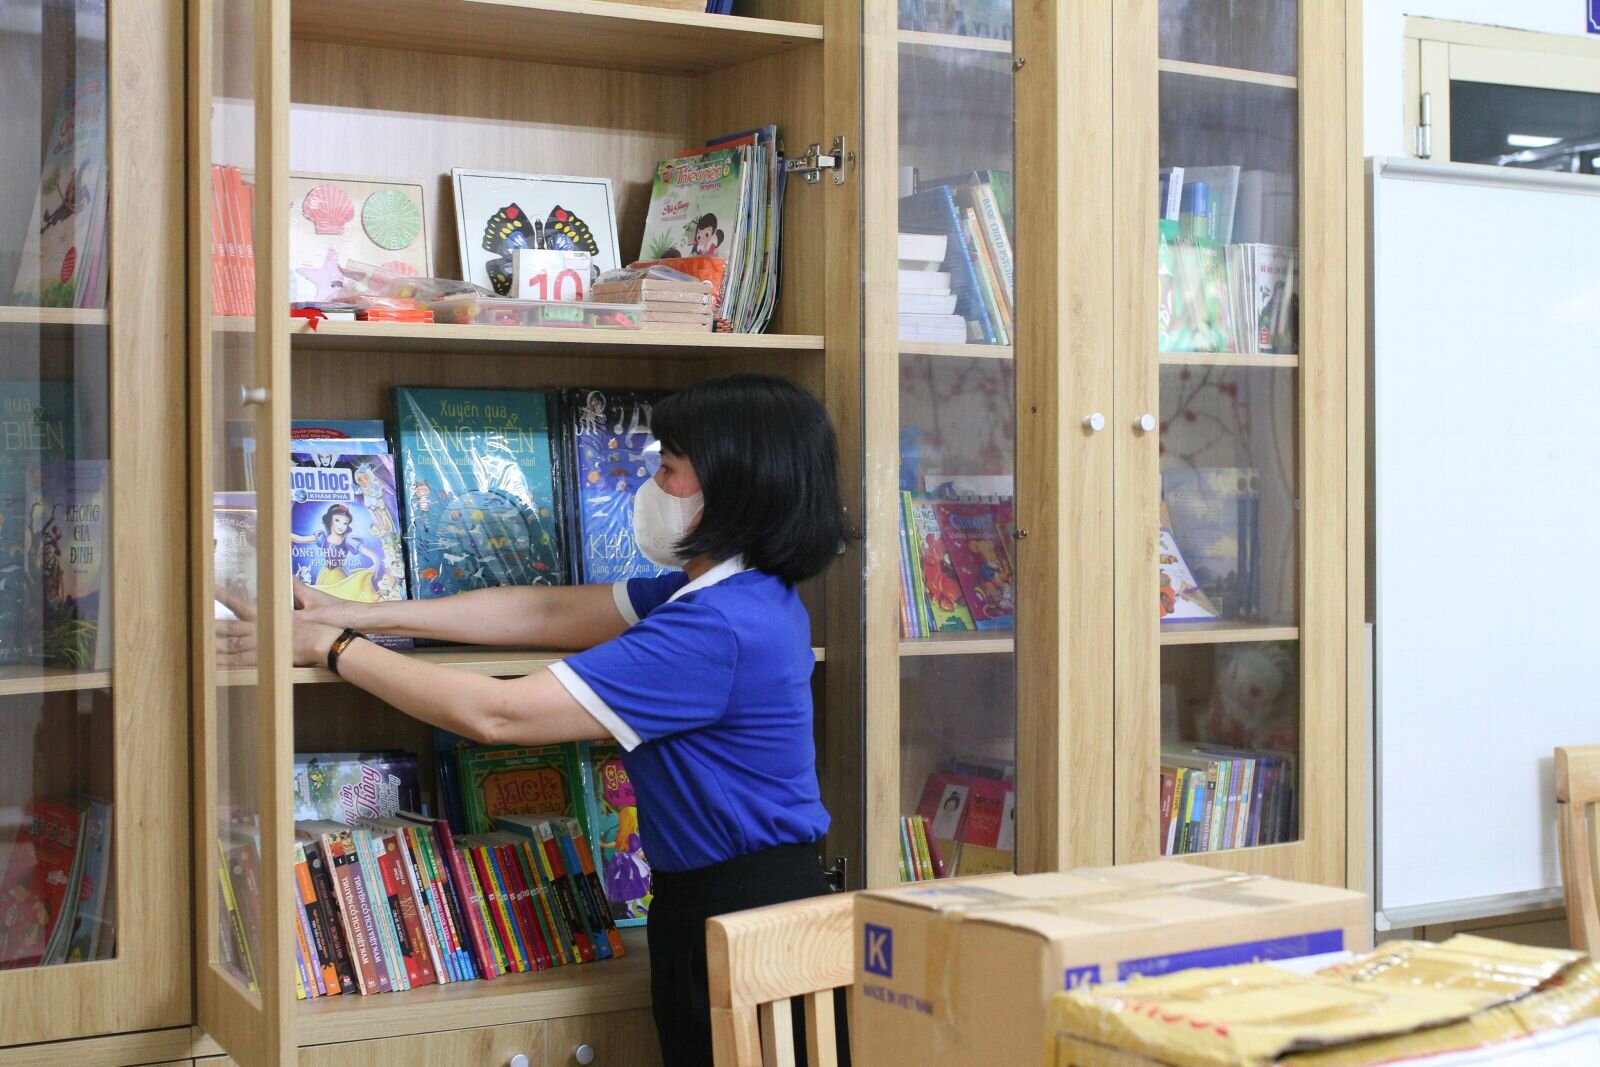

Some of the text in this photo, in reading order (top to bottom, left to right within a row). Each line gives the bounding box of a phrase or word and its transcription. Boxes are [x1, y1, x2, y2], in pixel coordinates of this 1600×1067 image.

[983, 198, 995, 221] BASIC
[990, 223, 1004, 248] CHILD
[529, 268, 583, 300] 10
[4, 398, 31, 415] qua
[441, 400, 507, 423] Xuyên qua
[318, 470, 350, 493] học
[309, 492, 347, 500] KHÁM PHÁ
[73, 524, 90, 542] GIA
[292, 545, 346, 557] ÔNG CHÚA
[590, 528, 636, 559] KHÔ
[354, 876, 367, 903] TRUYỆN
[361, 903, 371, 915] CỔ
[342, 877, 369, 964] TRUYỆN CỔ TÍCH VIỆT NAM
[364, 915, 373, 931] TÍCH
[367, 931, 378, 947] VIỆT
[372, 946, 382, 963] NAM
[868, 929, 889, 972] K
